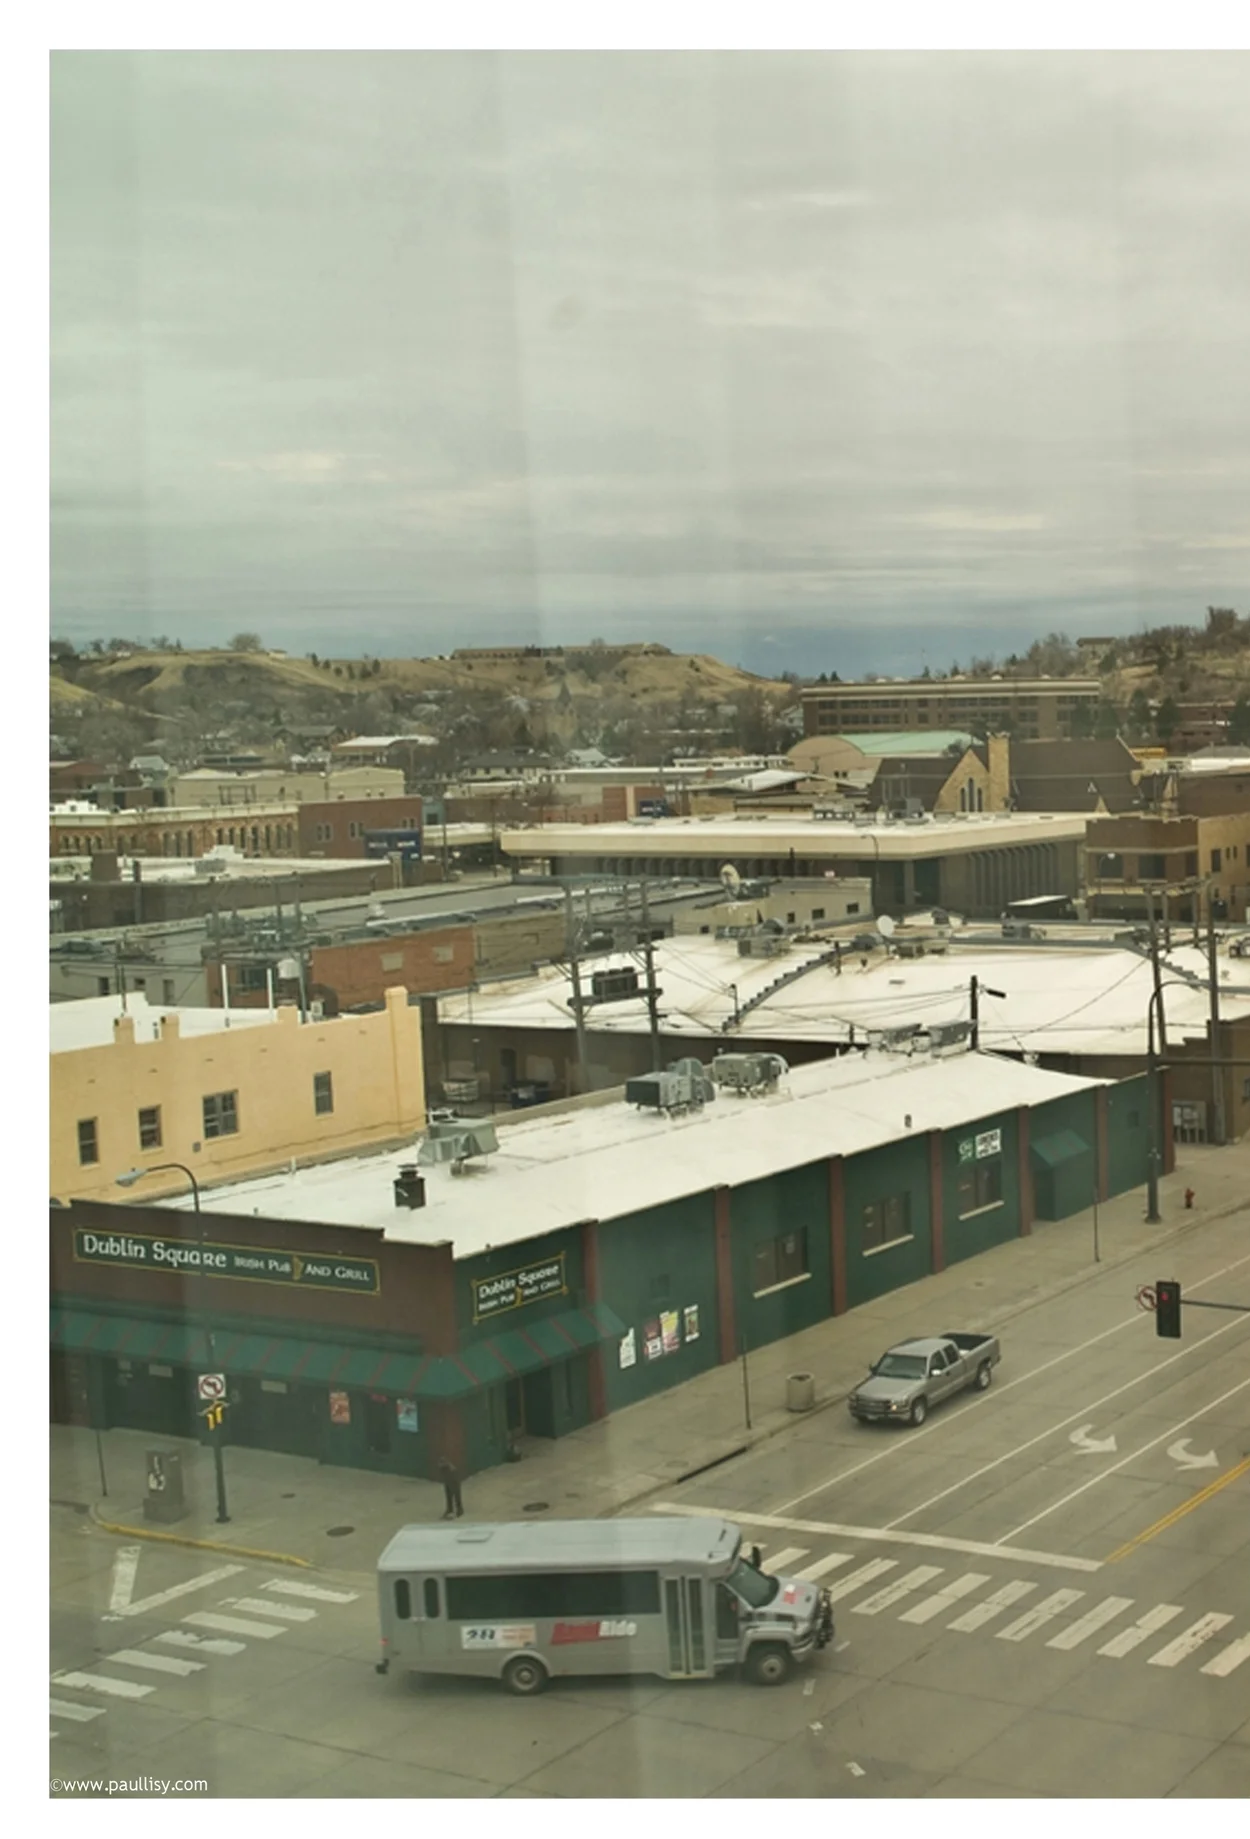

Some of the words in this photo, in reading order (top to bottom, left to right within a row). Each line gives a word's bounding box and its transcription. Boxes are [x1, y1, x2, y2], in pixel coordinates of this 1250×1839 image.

[83, 1234, 146, 1259] Dublin
[152, 1241, 227, 1268] Square
[479, 1278, 517, 1299] Dublin
